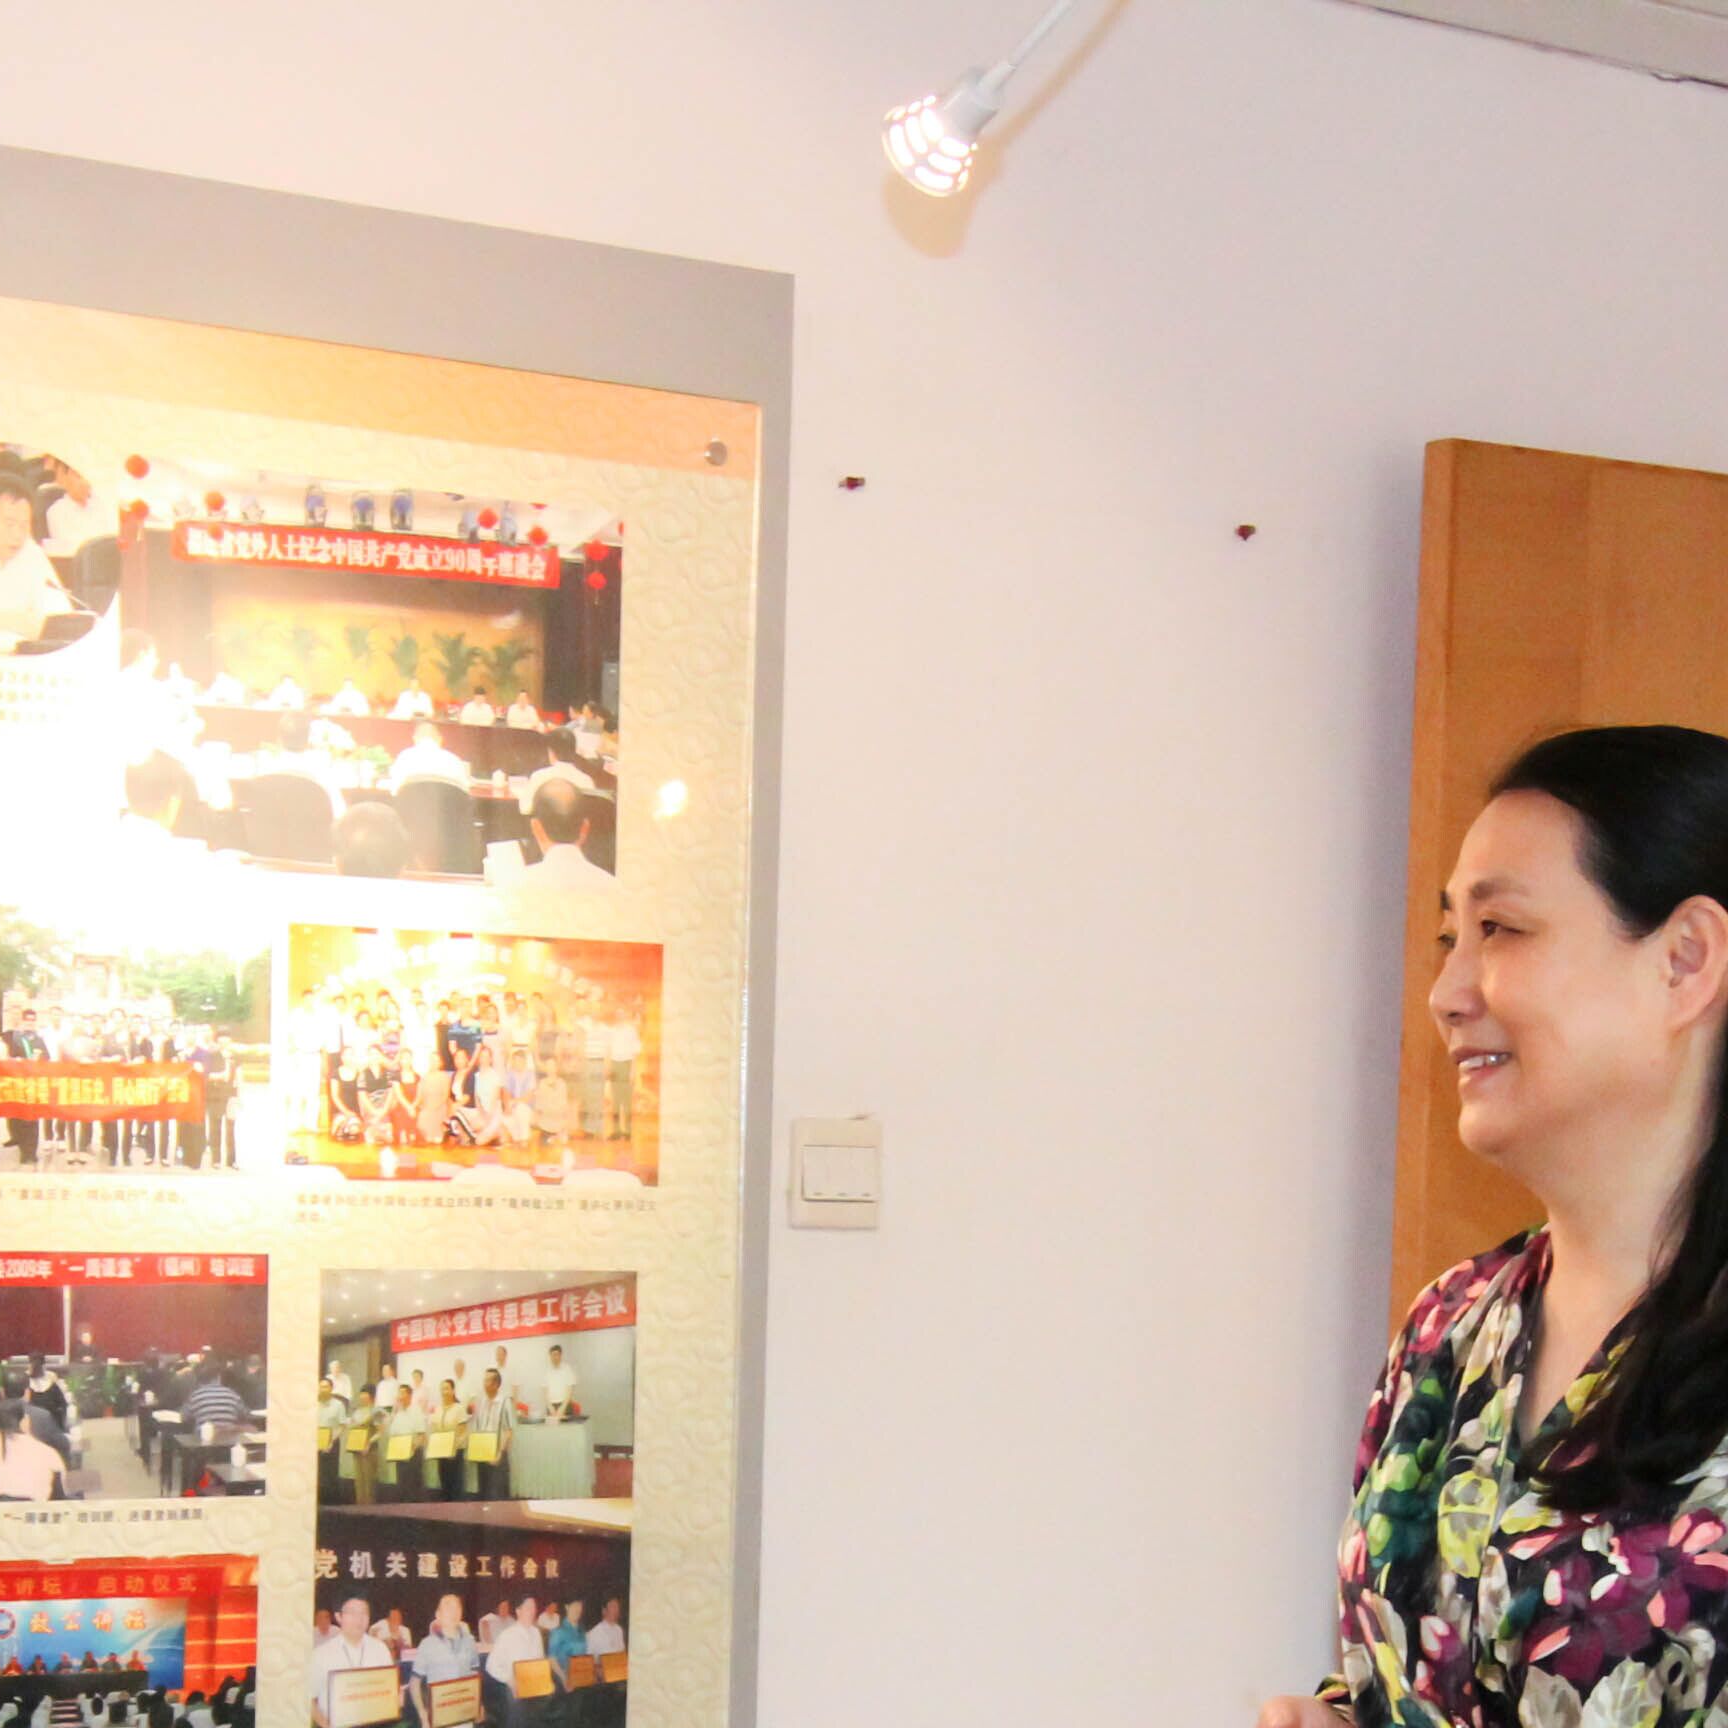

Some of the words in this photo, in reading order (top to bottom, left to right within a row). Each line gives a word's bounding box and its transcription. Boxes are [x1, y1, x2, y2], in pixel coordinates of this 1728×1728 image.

[397, 1286, 628, 1344] 中国致公党宣传思想工作会议
[315, 1548, 560, 1580] 党机关建设工作会议
